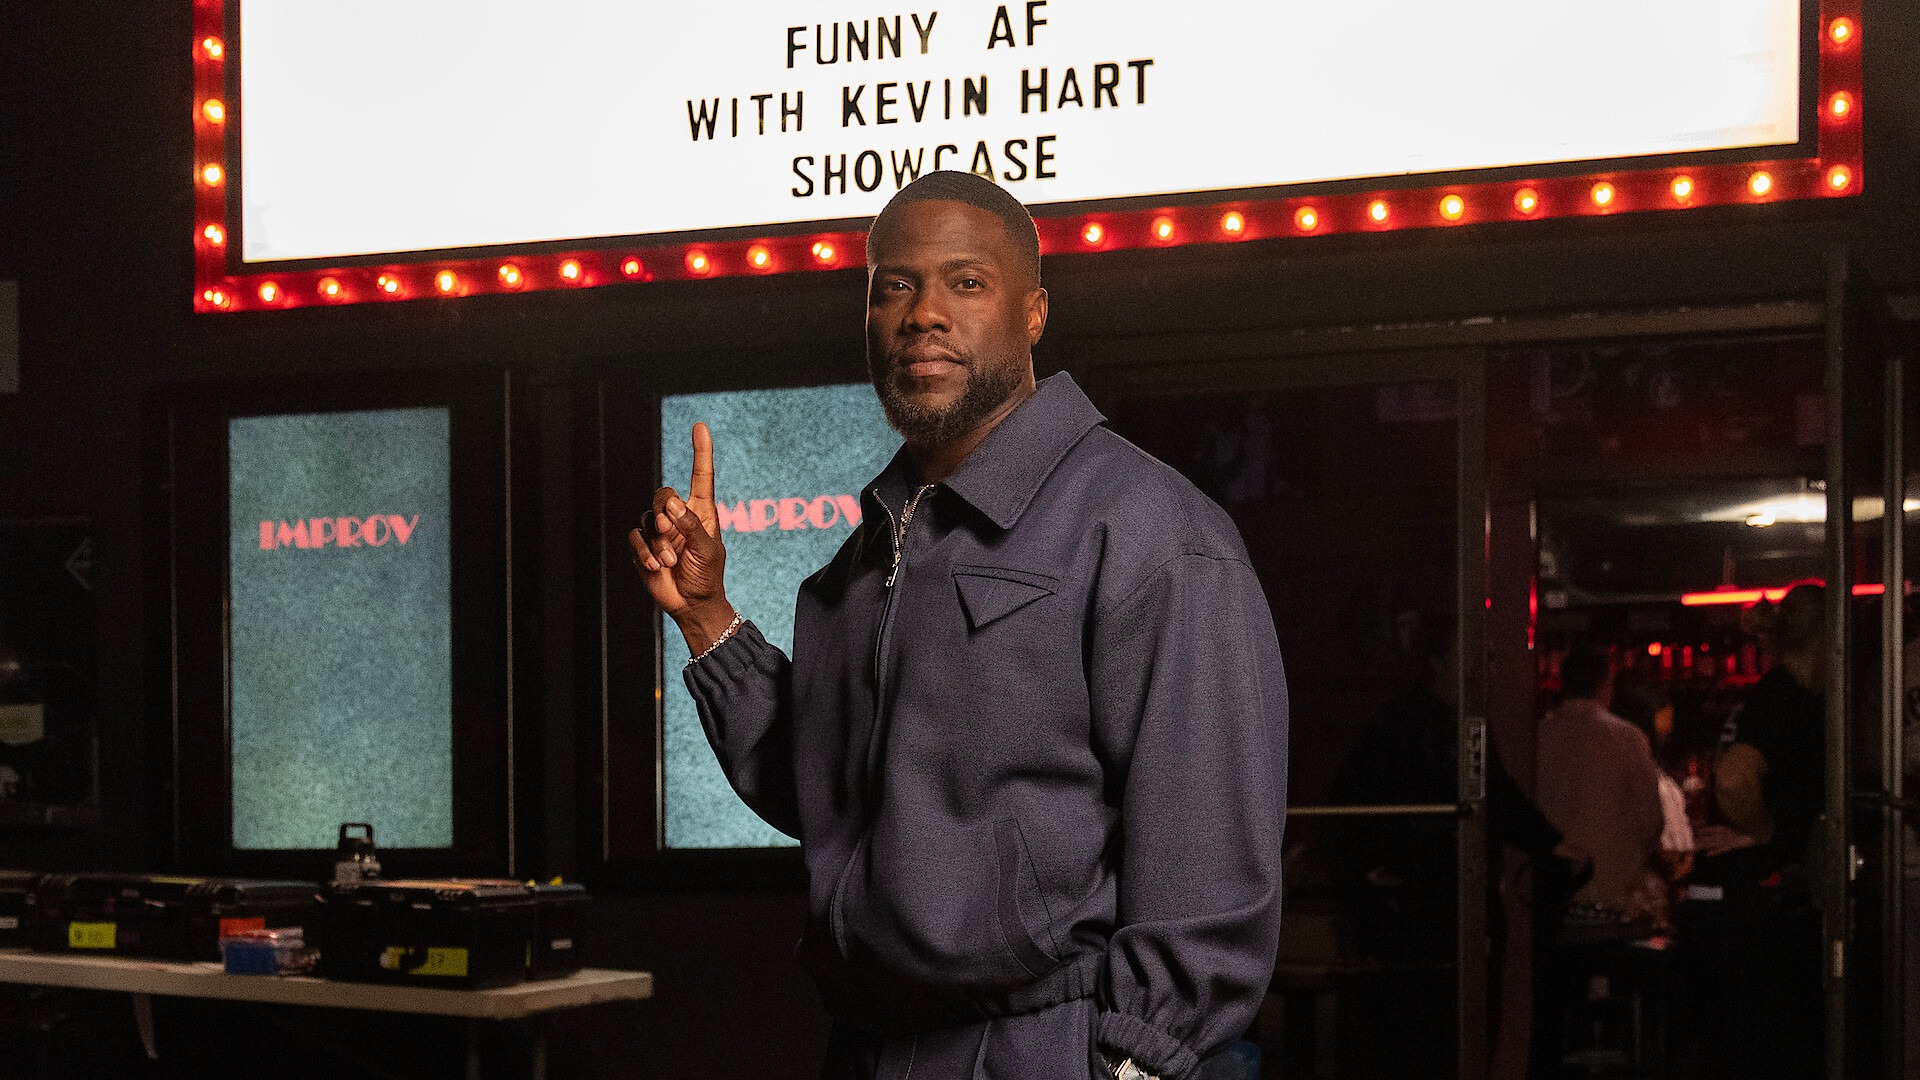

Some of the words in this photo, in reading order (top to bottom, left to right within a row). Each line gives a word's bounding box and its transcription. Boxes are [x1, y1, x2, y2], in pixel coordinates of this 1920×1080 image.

[787, 11, 938, 69] FUNNY
[987, 0, 1048, 50] AF
[687, 91, 804, 141] WITH
[842, 75, 988, 128] KEVIN
[1021, 59, 1154, 114] HART
[791, 134, 1057, 198] SHOWCASE
[259, 514, 420, 550] IMPROV
[717, 494, 862, 532] MPROV
